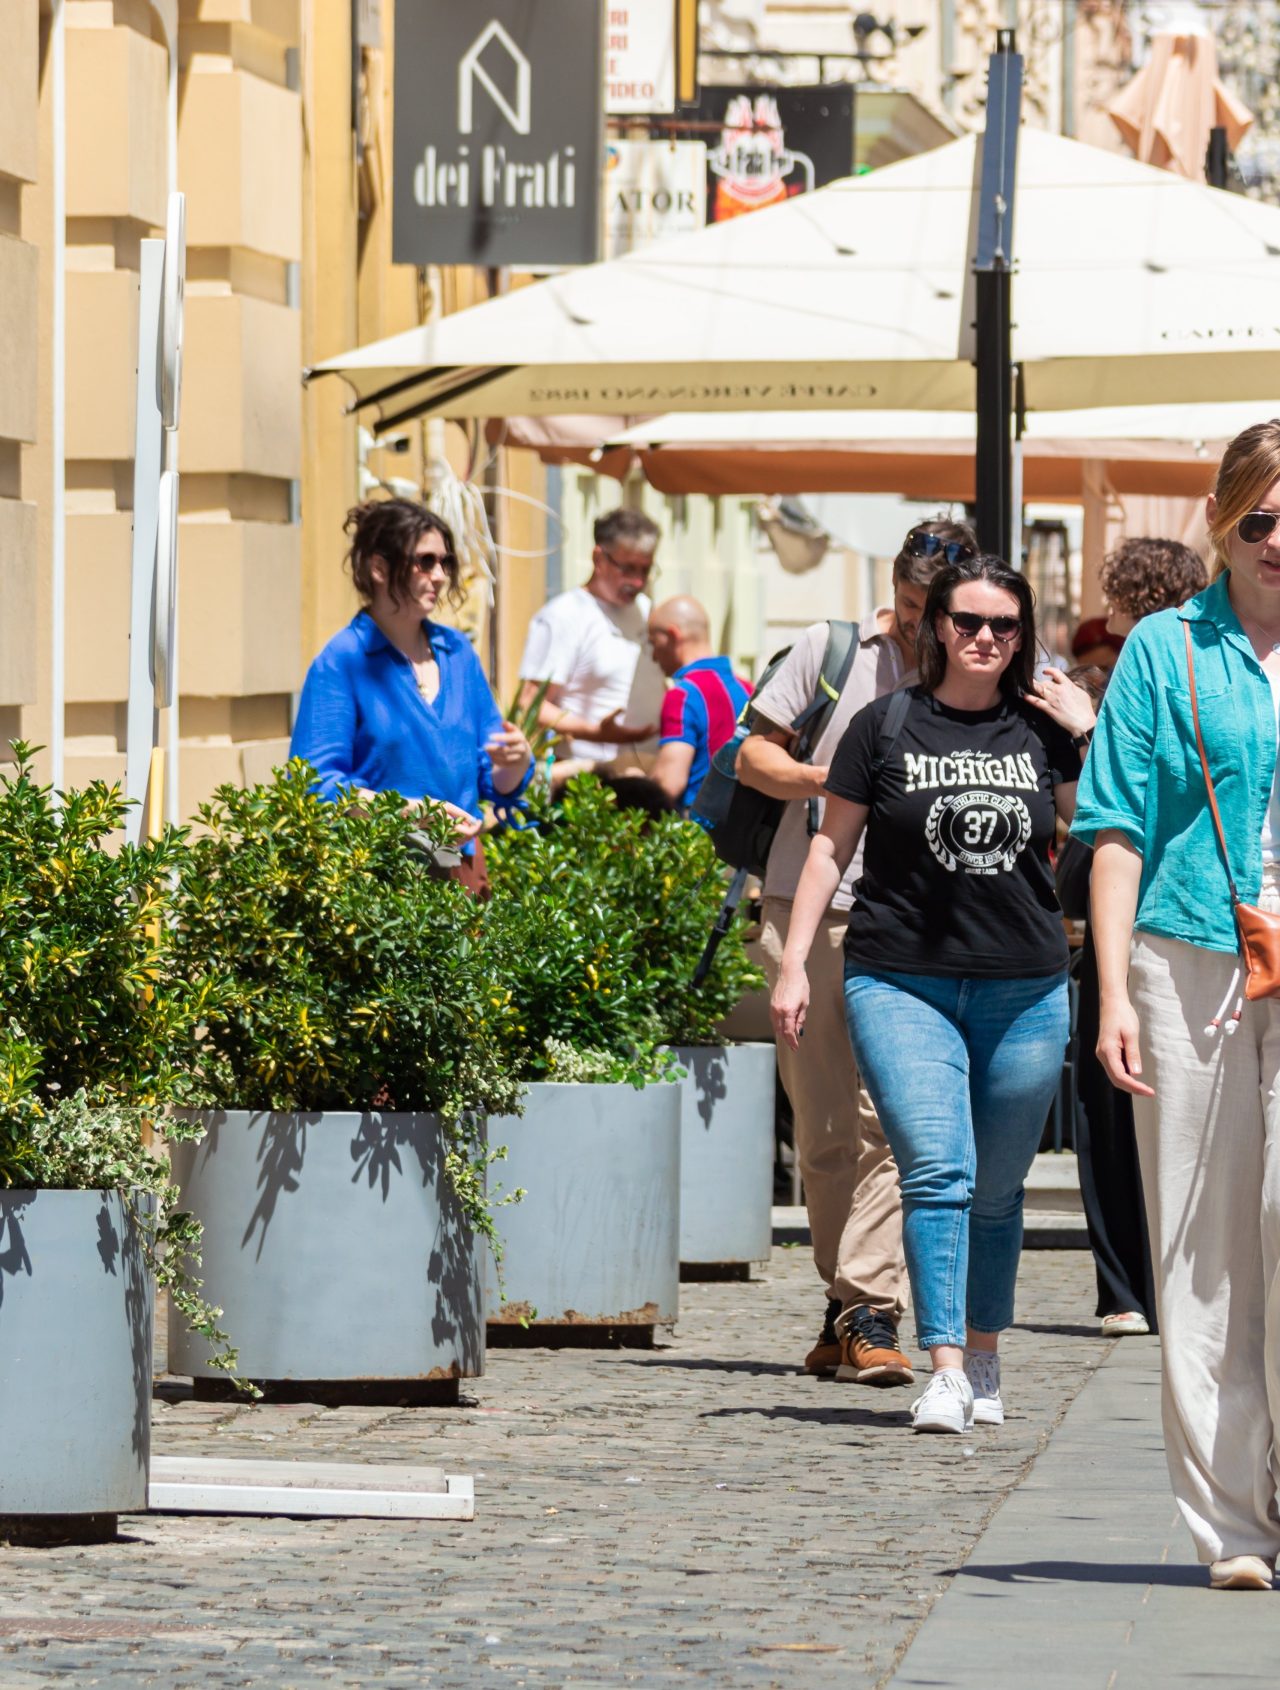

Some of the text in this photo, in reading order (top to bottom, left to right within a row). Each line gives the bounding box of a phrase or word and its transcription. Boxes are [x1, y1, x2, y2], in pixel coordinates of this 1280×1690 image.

[608, 81, 655, 98] IDEO
[414, 145, 575, 208] dei Frati
[904, 752, 1039, 792] MICHIGAN
[950, 794, 1012, 814] ATHLETIC CLUB
[964, 811, 998, 844] 37
[959, 851, 983, 865] SINCE
